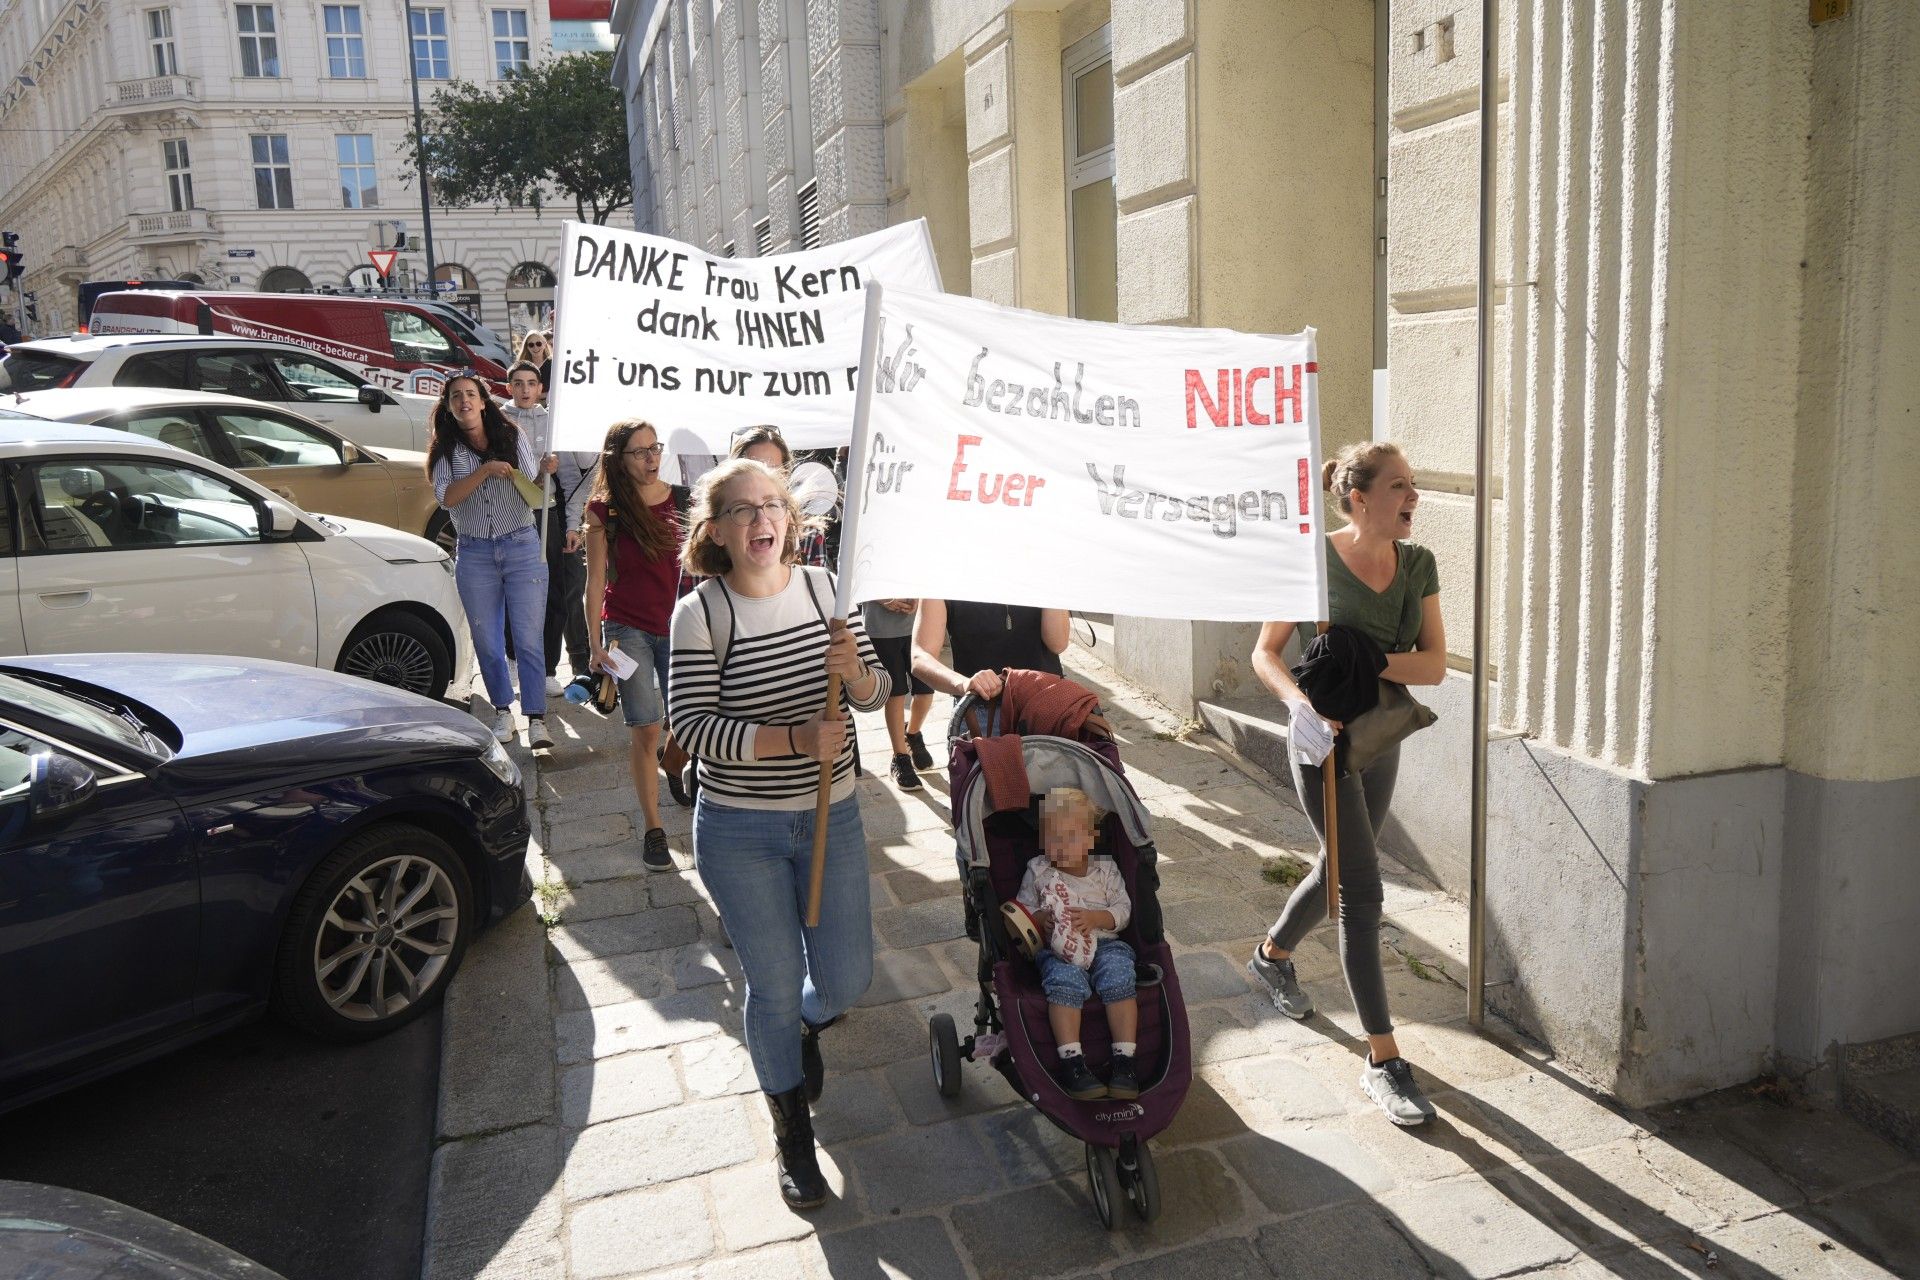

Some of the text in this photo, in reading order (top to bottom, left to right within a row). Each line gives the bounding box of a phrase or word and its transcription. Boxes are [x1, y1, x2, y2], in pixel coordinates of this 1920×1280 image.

[574, 235, 861, 303] DANKE Frau Kern
[231, 323, 369, 363] www.brandschutz-becker.at
[637, 299, 825, 349] dank IHNEN
[563, 349, 600, 385] ist
[617, 361, 681, 391] uns
[695, 367, 752, 397] nur
[764, 370, 831, 397] zum
[875, 317, 926, 394] Wir
[962, 346, 1141, 428] bezahlen
[862, 431, 914, 514] für
[946, 434, 1046, 507] Euer
[1095, 1111, 1112, 1122] city
[1113, 1109, 1134, 1119] mini
